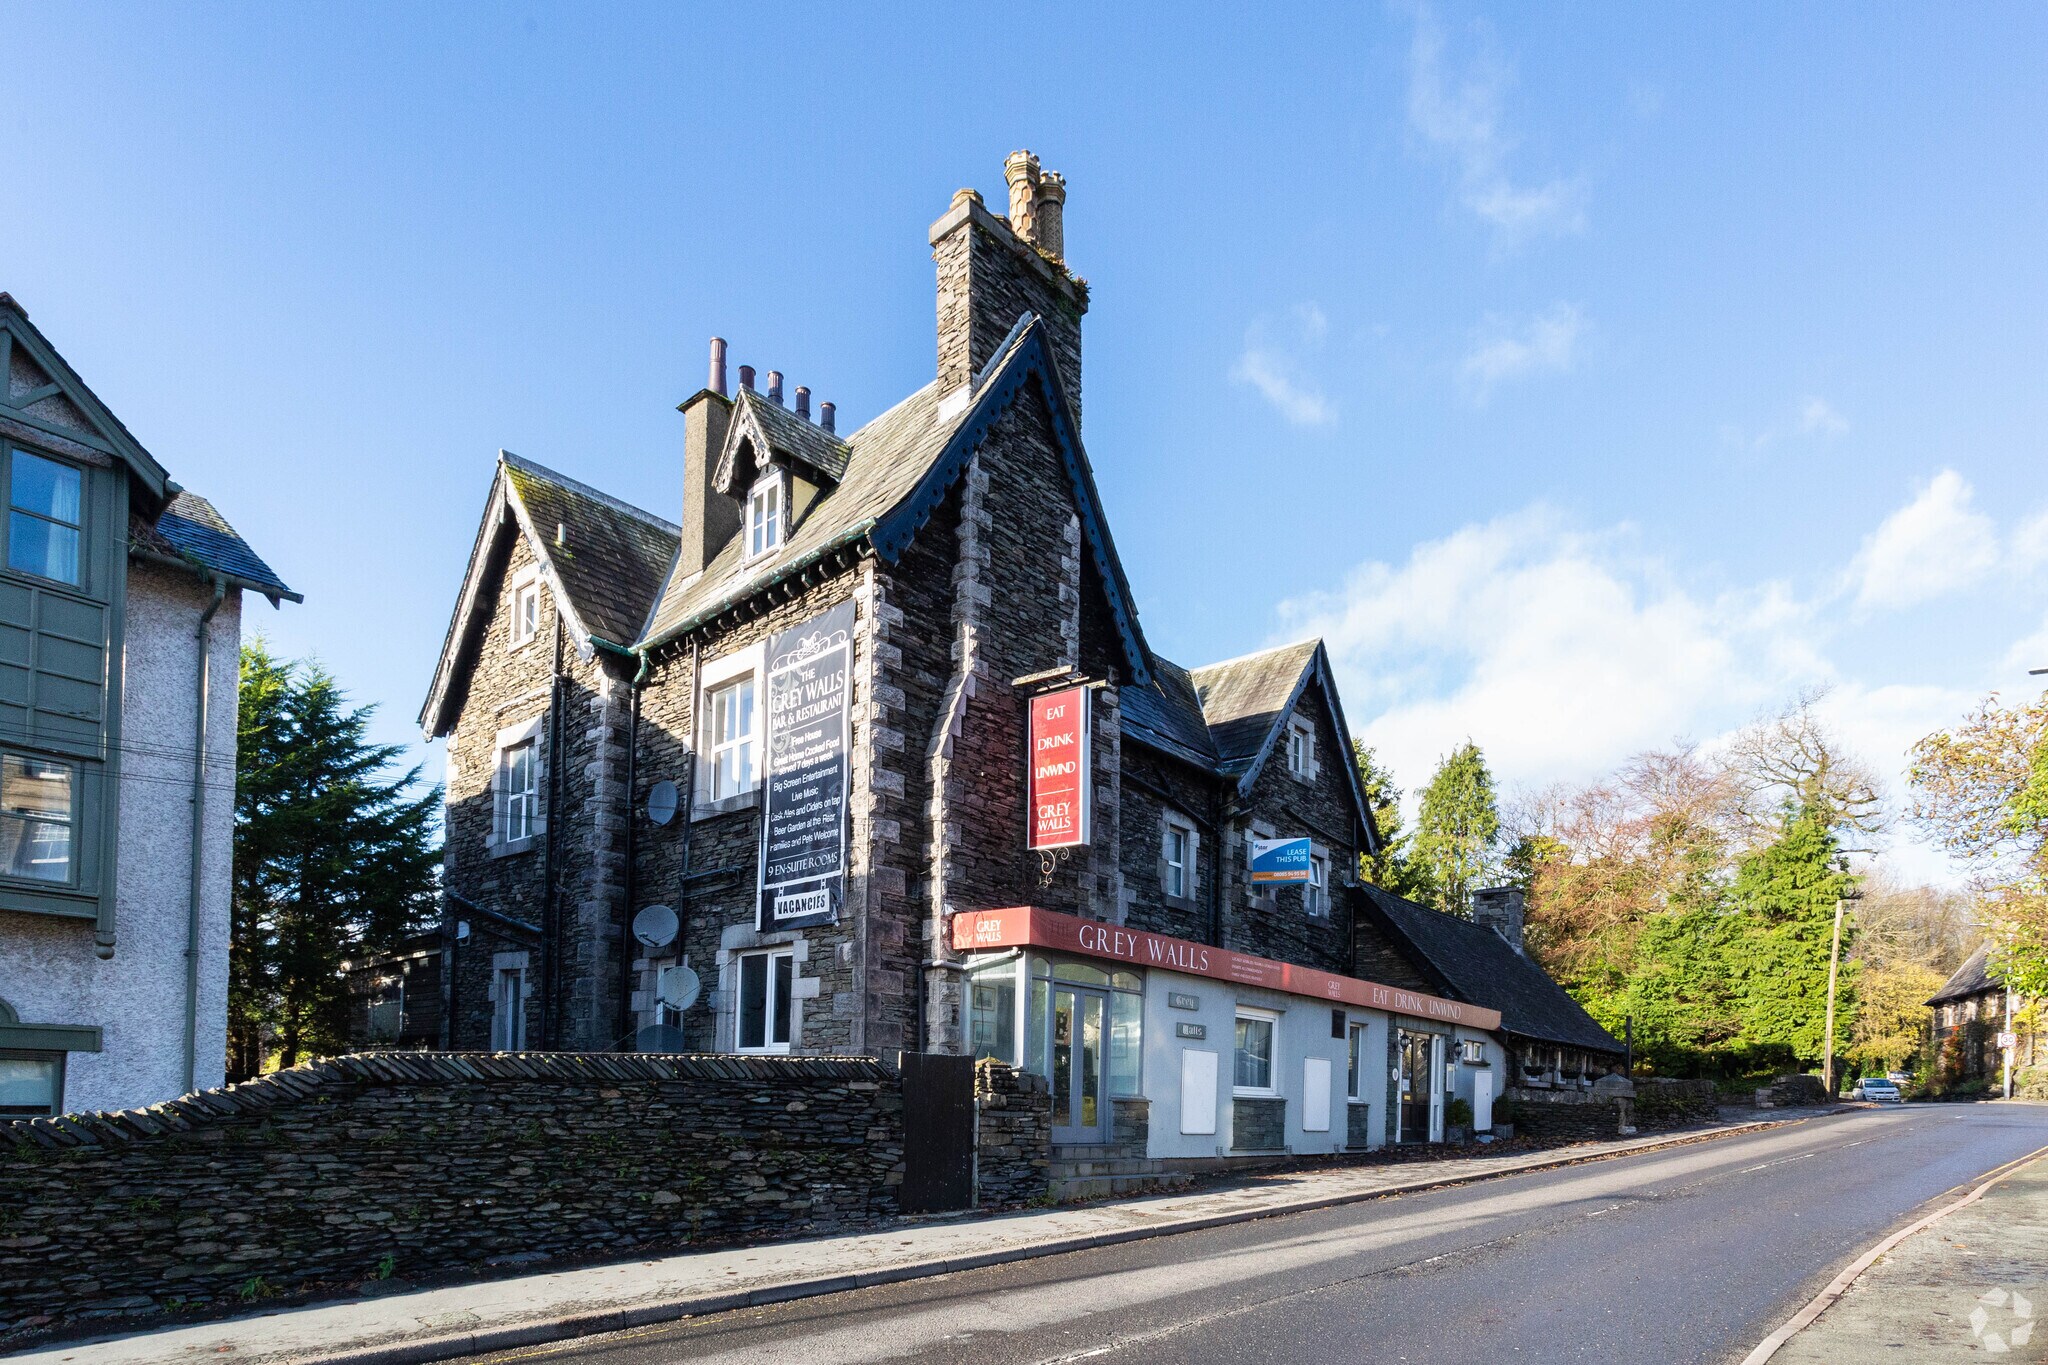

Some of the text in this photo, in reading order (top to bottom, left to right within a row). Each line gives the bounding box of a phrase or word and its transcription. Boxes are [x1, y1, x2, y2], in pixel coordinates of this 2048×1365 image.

[800, 668, 816, 682] THE
[772, 670, 844, 713] GREY WALLS
[772, 692, 844, 730] BAR & RESTAURANT
[1046, 705, 1066, 720] EAT
[792, 730, 822, 747] Free House
[1037, 732, 1074, 751] DRINK
[773, 736, 840, 767] Great Home Cooked Food
[778, 763, 797, 776] served
[796, 760, 801, 770] 7
[801, 756, 814, 768] days
[820, 750, 834, 762] week
[1036, 760, 1076, 780] UNWIND
[774, 764, 838, 792] Big Screen Entertainment
[792, 786, 819, 802] Live Music
[770, 810, 784, 822] Cask
[796, 804, 806, 816] and
[806, 799, 823, 813] Ciders
[824, 798, 832, 808] on
[832, 796, 840, 807] tap
[1038, 802, 1071, 819] GREY
[774, 813, 836, 836] Beer Garden at the Rear
[1038, 816, 1071, 832] WALLS
[791, 836, 802, 847] and
[802, 834, 813, 844] Pets
[814, 828, 839, 840] Welcome
[768, 852, 838, 876] 9 EN-SUITE ROOMS
[778, 894, 826, 914] VACANCIES
[976, 919, 1002, 932] GREY
[976, 931, 1002, 942] WALLS
[1078, 924, 1138, 957] GREY
[1148, 938, 1209, 971] WALLS
[1328, 980, 1340, 990] GREY
[1328, 989, 1340, 998] WALLS
[1176, 996, 1194, 1008] Grey
[1373, 988, 1462, 1020] EAT DRINK UNWIND
[1182, 1024, 1202, 1036] Walls
